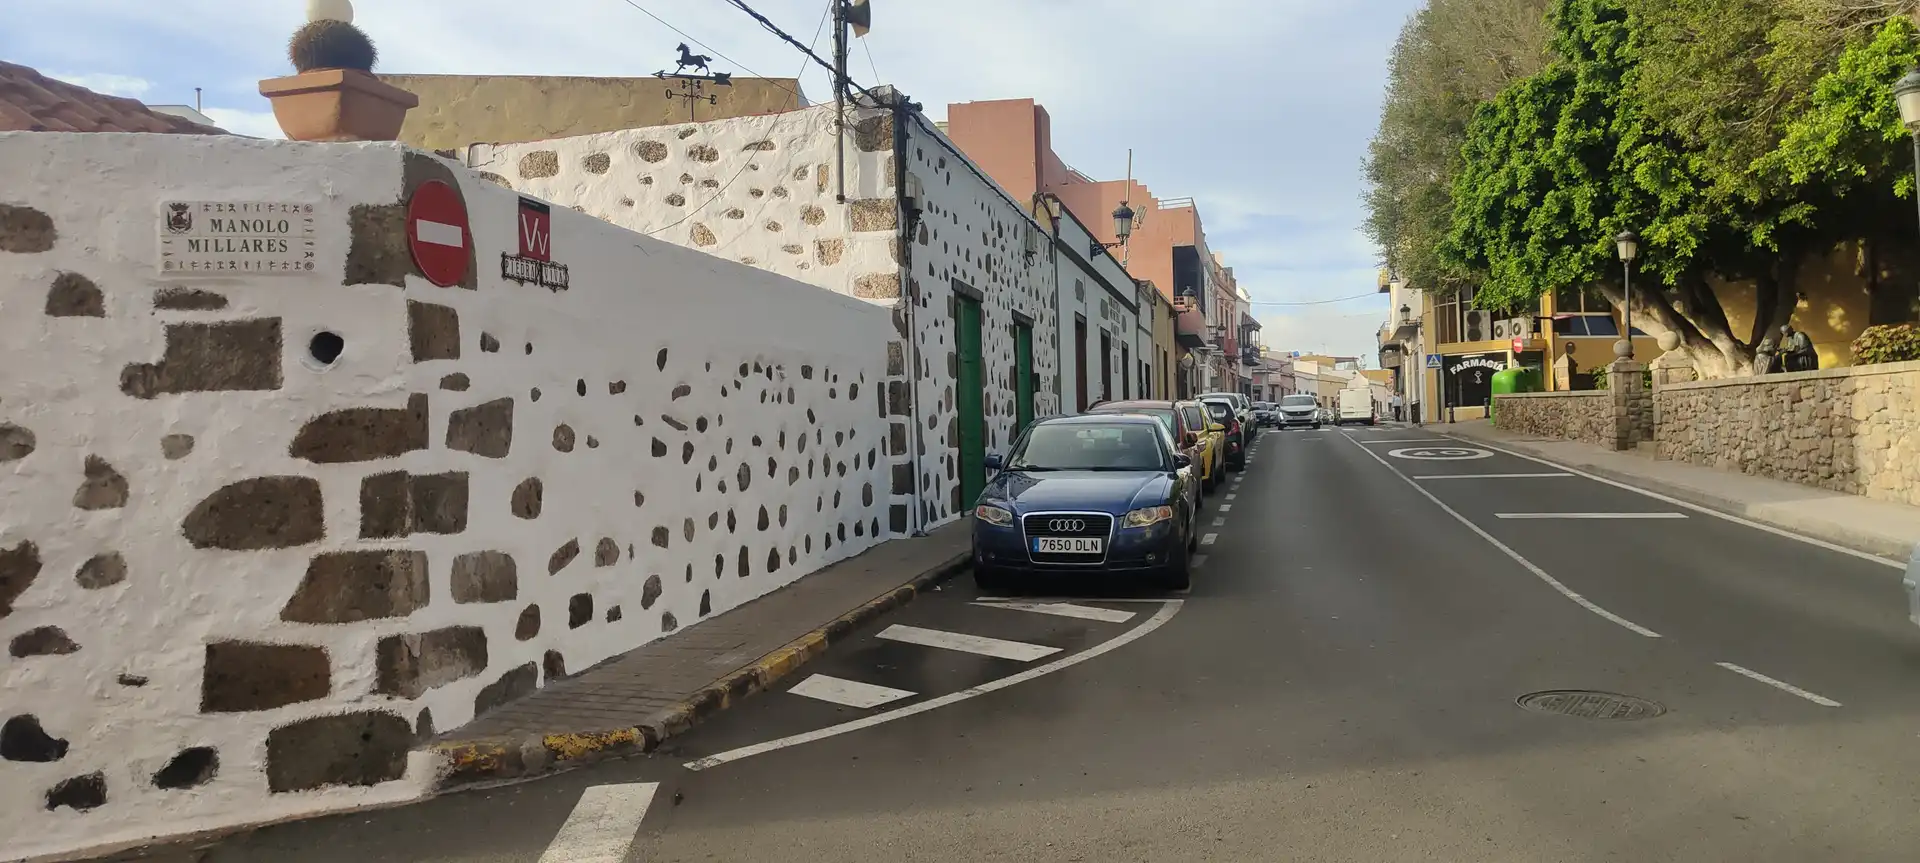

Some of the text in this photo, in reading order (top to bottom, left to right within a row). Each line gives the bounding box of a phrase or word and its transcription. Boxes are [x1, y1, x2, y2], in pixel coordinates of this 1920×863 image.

[210, 218, 290, 233] MANOLO
[188, 239, 289, 253] MILLARES
[505, 259, 567, 285] PIEDRA VIVA
[1450, 358, 1504, 375] FARMACIA
[1041, 539, 1099, 552] 7650 DLN
